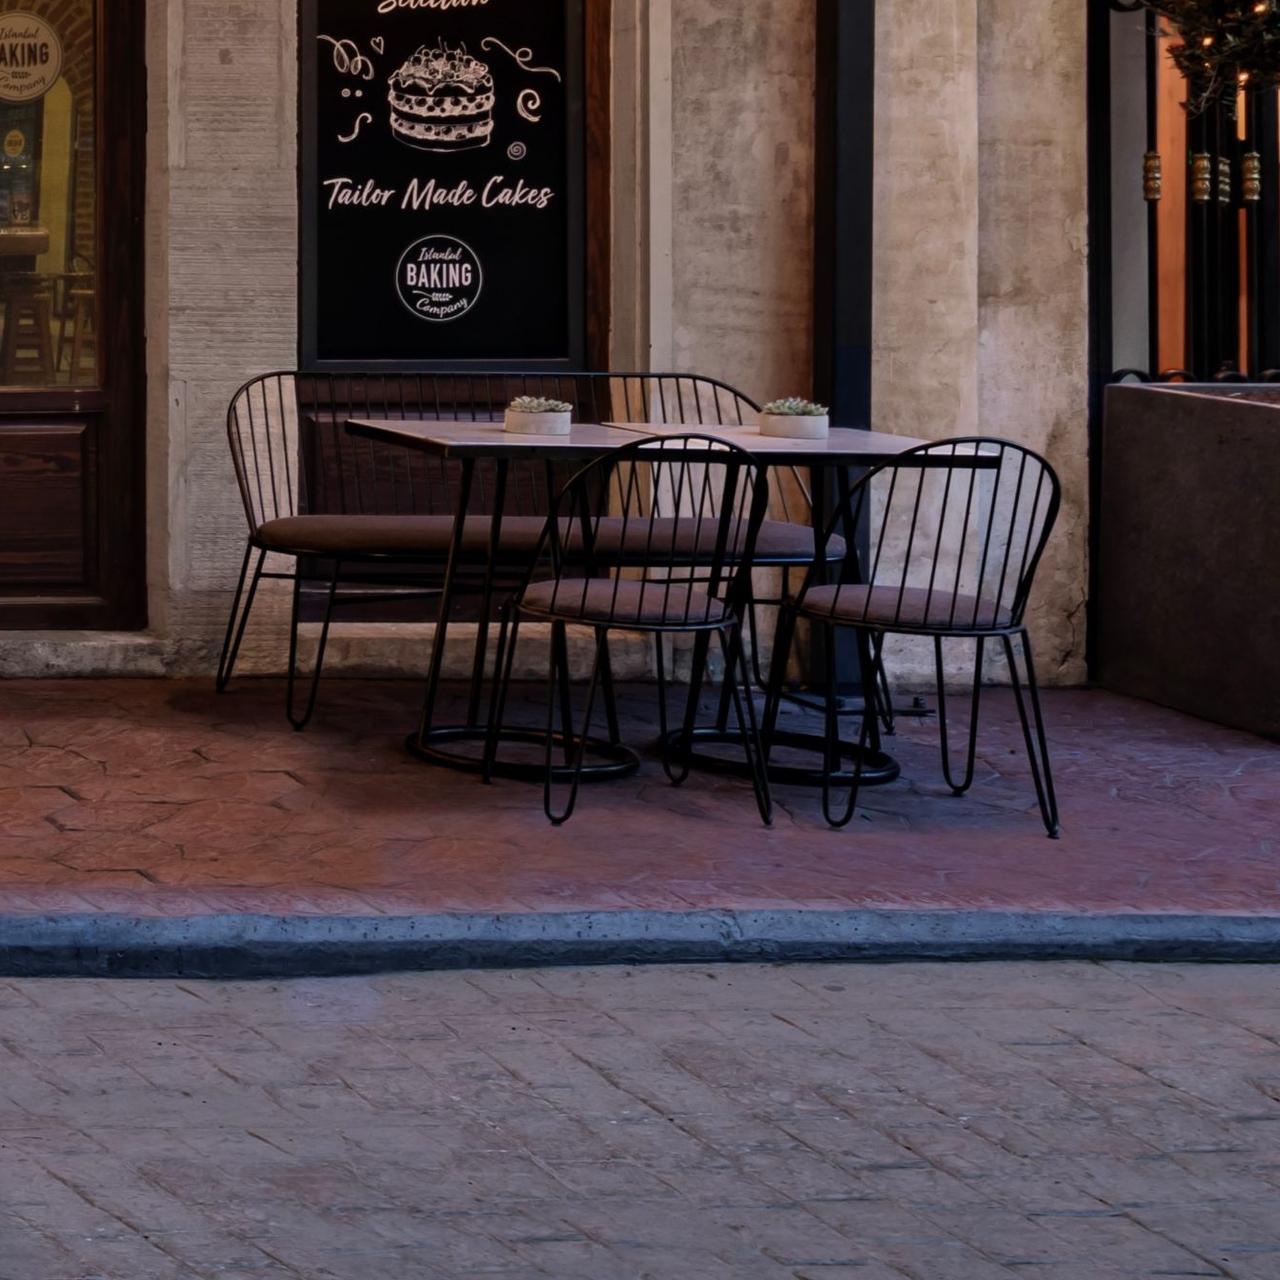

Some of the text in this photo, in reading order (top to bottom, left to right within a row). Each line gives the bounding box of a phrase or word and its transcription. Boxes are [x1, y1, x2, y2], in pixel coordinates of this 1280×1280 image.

[323, 175, 554, 210] Tailor Made Cakes
[417, 247, 462, 261] Istanbul
[406, 263, 472, 288] BAKING
[416, 298, 468, 318] Company
